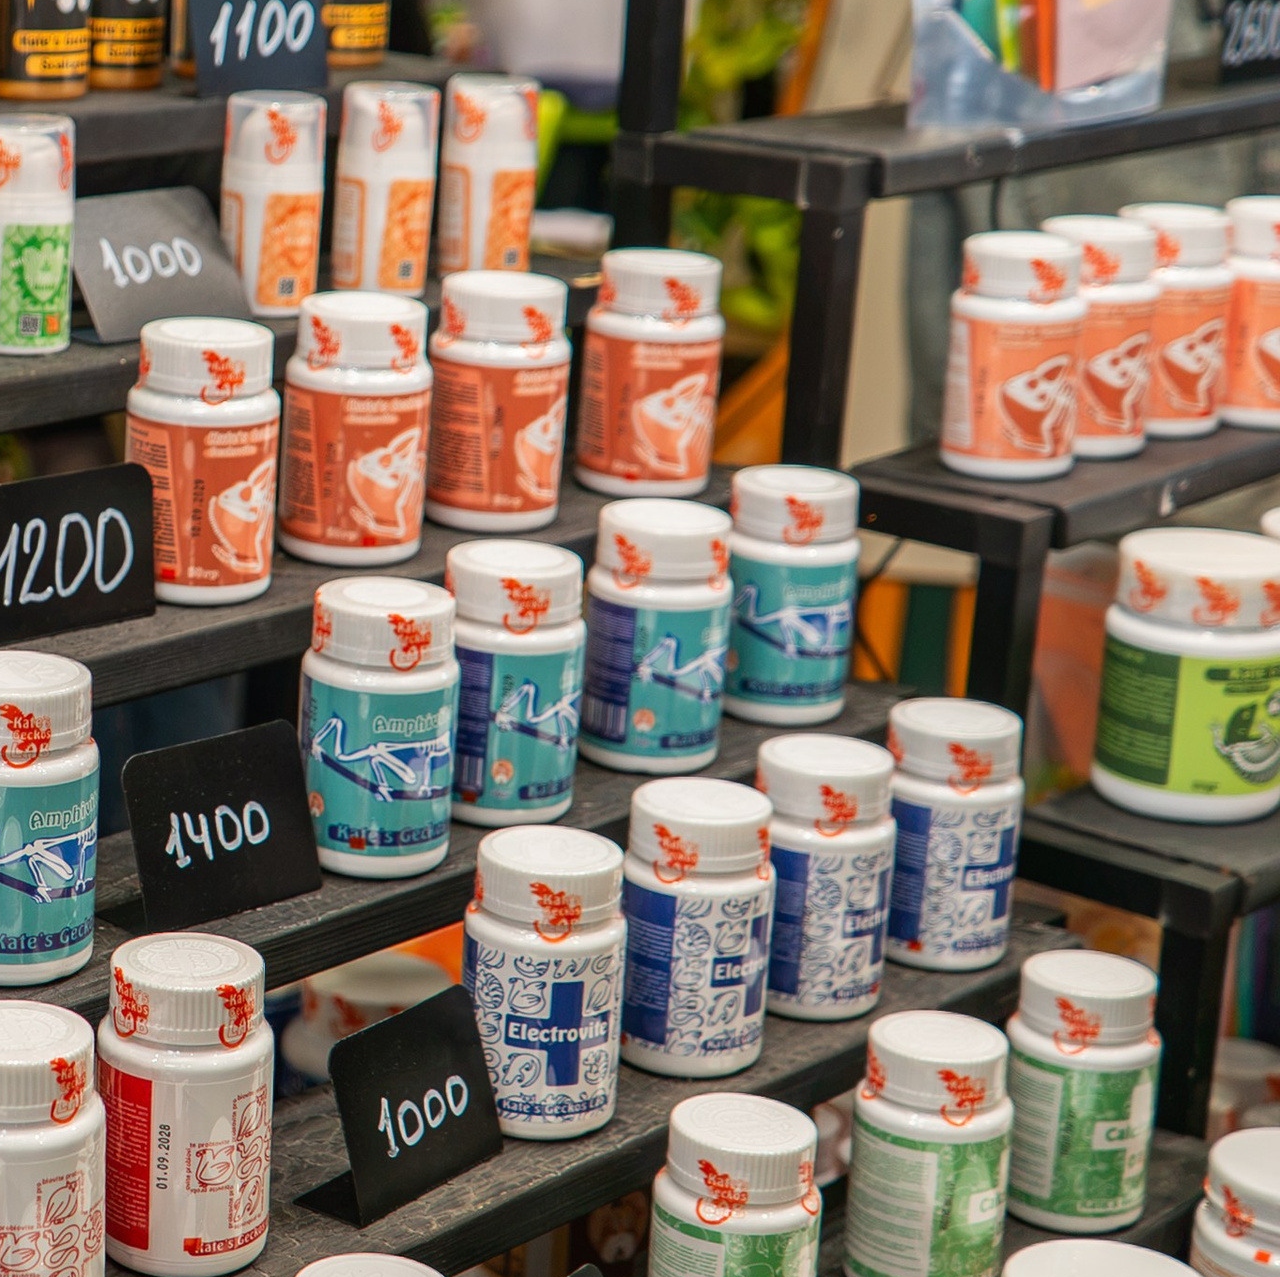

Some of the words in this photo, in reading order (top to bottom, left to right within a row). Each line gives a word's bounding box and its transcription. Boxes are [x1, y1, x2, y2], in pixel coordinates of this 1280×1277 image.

[100, 236, 203, 289] 1000
[12, 715, 51, 729] Kate's
[372, 706, 449, 737] Amphivi
[12, 728, 51, 741] Geckos
[10, 741, 51, 759] LAB
[29, 791, 98, 831] Amphivi
[165, 800, 271, 869] 1400
[337, 823, 393, 846] Kate's
[115, 1013, 150, 1035] LAB
[508, 1020, 609, 1043] Electrovite
[378, 1074, 468, 1158] 1000
[502, 1098, 541, 1115] Kate's
[545, 1099, 588, 1115] Geckos
[156, 1123, 171, 1190] 01.09.2028
[237, 1224, 267, 1246] Geckos
